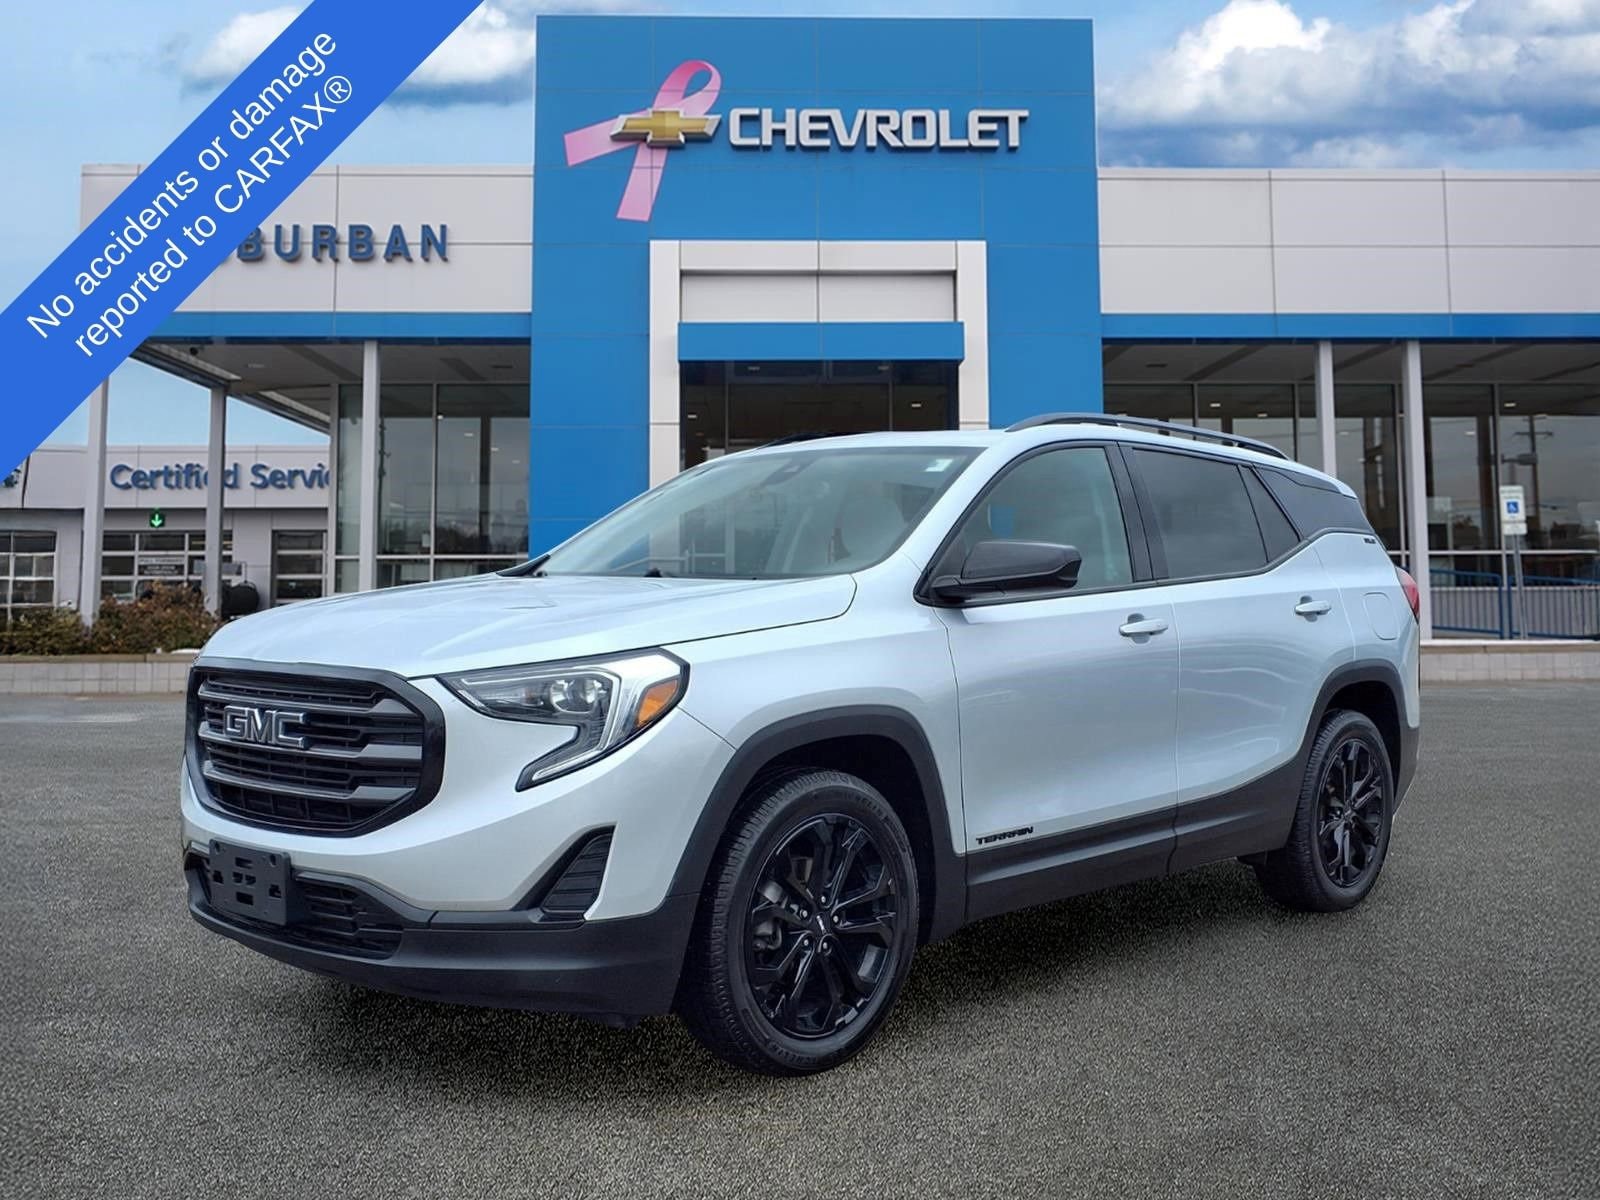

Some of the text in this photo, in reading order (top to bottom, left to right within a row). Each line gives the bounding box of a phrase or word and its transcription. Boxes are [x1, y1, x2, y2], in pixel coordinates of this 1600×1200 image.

[728, 107, 1029, 149] CHEVROLET
[223, 705, 307, 749] GMC
[975, 826, 1034, 845] TERRAIN
